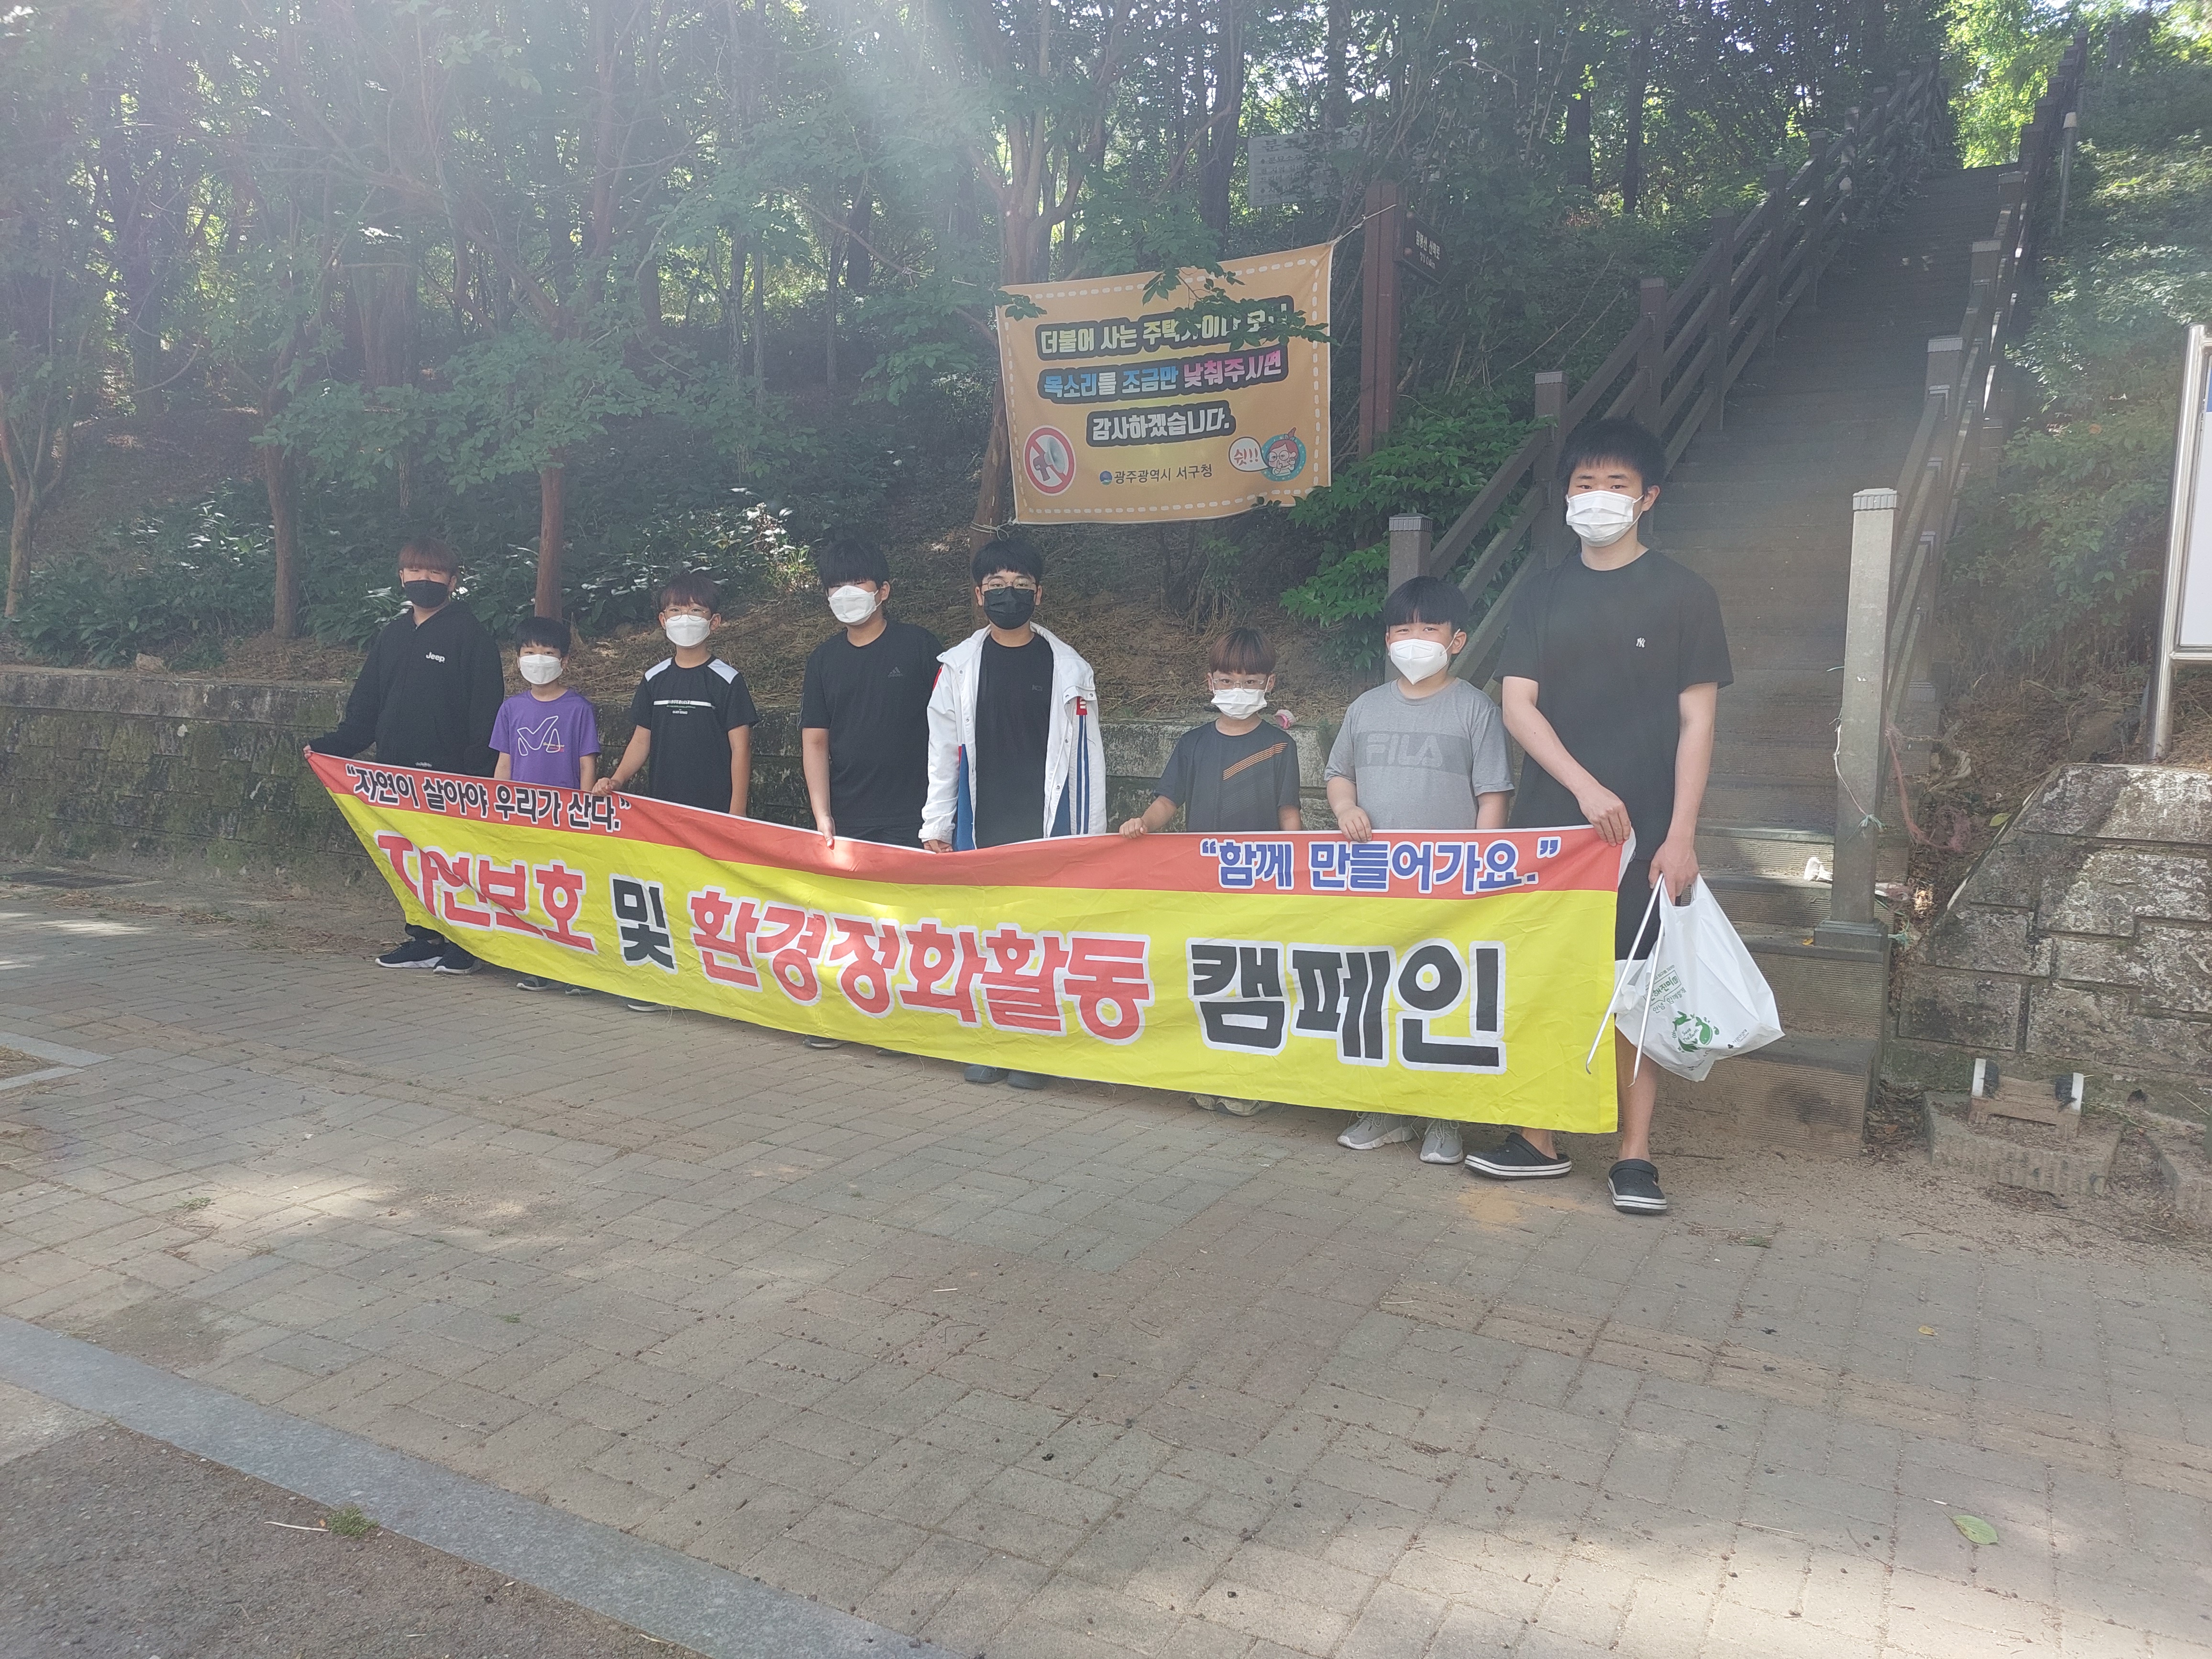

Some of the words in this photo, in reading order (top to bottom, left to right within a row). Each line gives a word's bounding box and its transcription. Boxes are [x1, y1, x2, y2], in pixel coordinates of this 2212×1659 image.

[1041, 328, 1095, 354] 더불어
[1100, 325, 1137, 349] 사는
[1044, 371, 1117, 398] 목소리를
[1122, 366, 1179, 394] 조금만
[1183, 350, 1282, 388] 낮춰주시면
[1093, 407, 1230, 442] 감사하겠습니다.
[1114, 467, 1172, 484] 광주광역시
[1176, 463, 1213, 480] 서구청
[426, 652, 445, 663] Jeep
[1366, 733, 1443, 767] FILA
[422, 777, 488, 819] 살아야
[495, 785, 561, 827] 우리가
[610, 874, 678, 974] 및
[687, 885, 1154, 1045] 환경정화활동
[1186, 939, 1506, 1074] 캠페인
